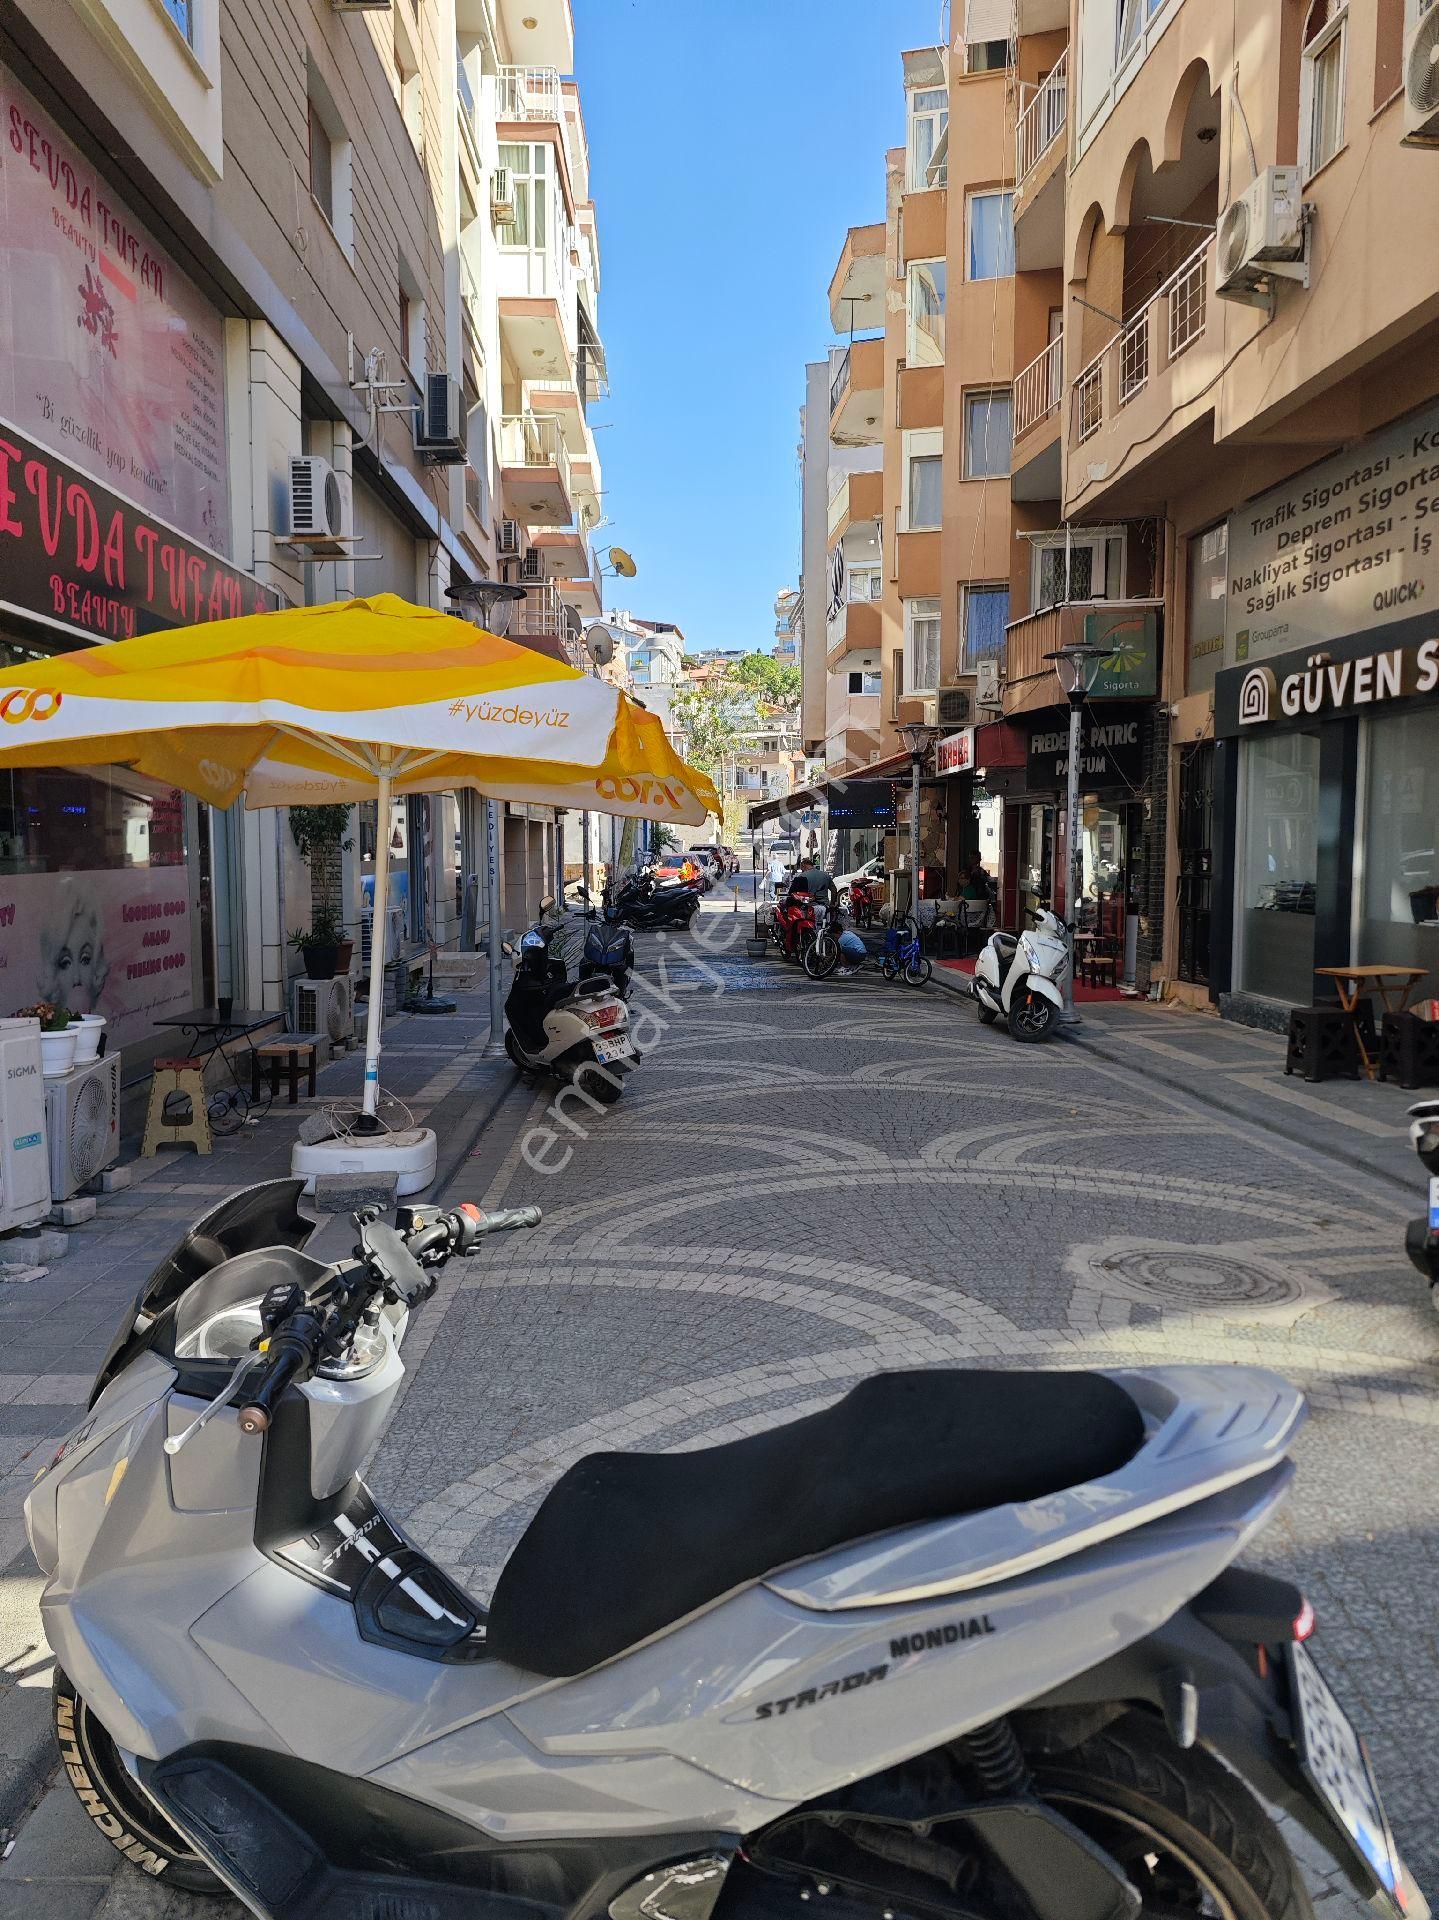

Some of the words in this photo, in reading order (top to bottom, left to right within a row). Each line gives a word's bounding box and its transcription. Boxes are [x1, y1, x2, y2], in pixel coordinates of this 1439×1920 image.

[9, 104, 91, 228] SEVDA
[97, 201, 163, 303] TUFAN
[60, 415, 102, 455] güzellik
[1251, 501, 1297, 536] Trafik
[1301, 456, 1390, 512] Sigortası
[1277, 506, 1351, 550] Deprem
[1232, 554, 1298, 595] Nakliyat
[1303, 517, 1393, 566] Sigortası
[1246, 581, 1297, 614] Sağlık
[1302, 548, 1390, 593] Sigortası
[1413, 526, 1432, 556] İş
[50, 574, 135, 640] BEAUTY
[1373, 579, 1418, 612] QUICK
[1251, 623, 1289, 643] Groupama
[1103, 680, 1140, 692] Sigorta
[1280, 649, 1402, 716] GÜVEN
[448, 699, 570, 729] #yüzdeyüz
[1090, 722, 1138, 749] PATRIC
[937, 735, 969, 771] BERBER
[1055, 756, 1107, 776] PAFUM
[322, 1514, 381, 1572] STRADA
[889, 1614, 996, 1658] MONDIAL
[755, 1663, 889, 1721] STRADA
[57, 1695, 169, 1876] MICHELIN
